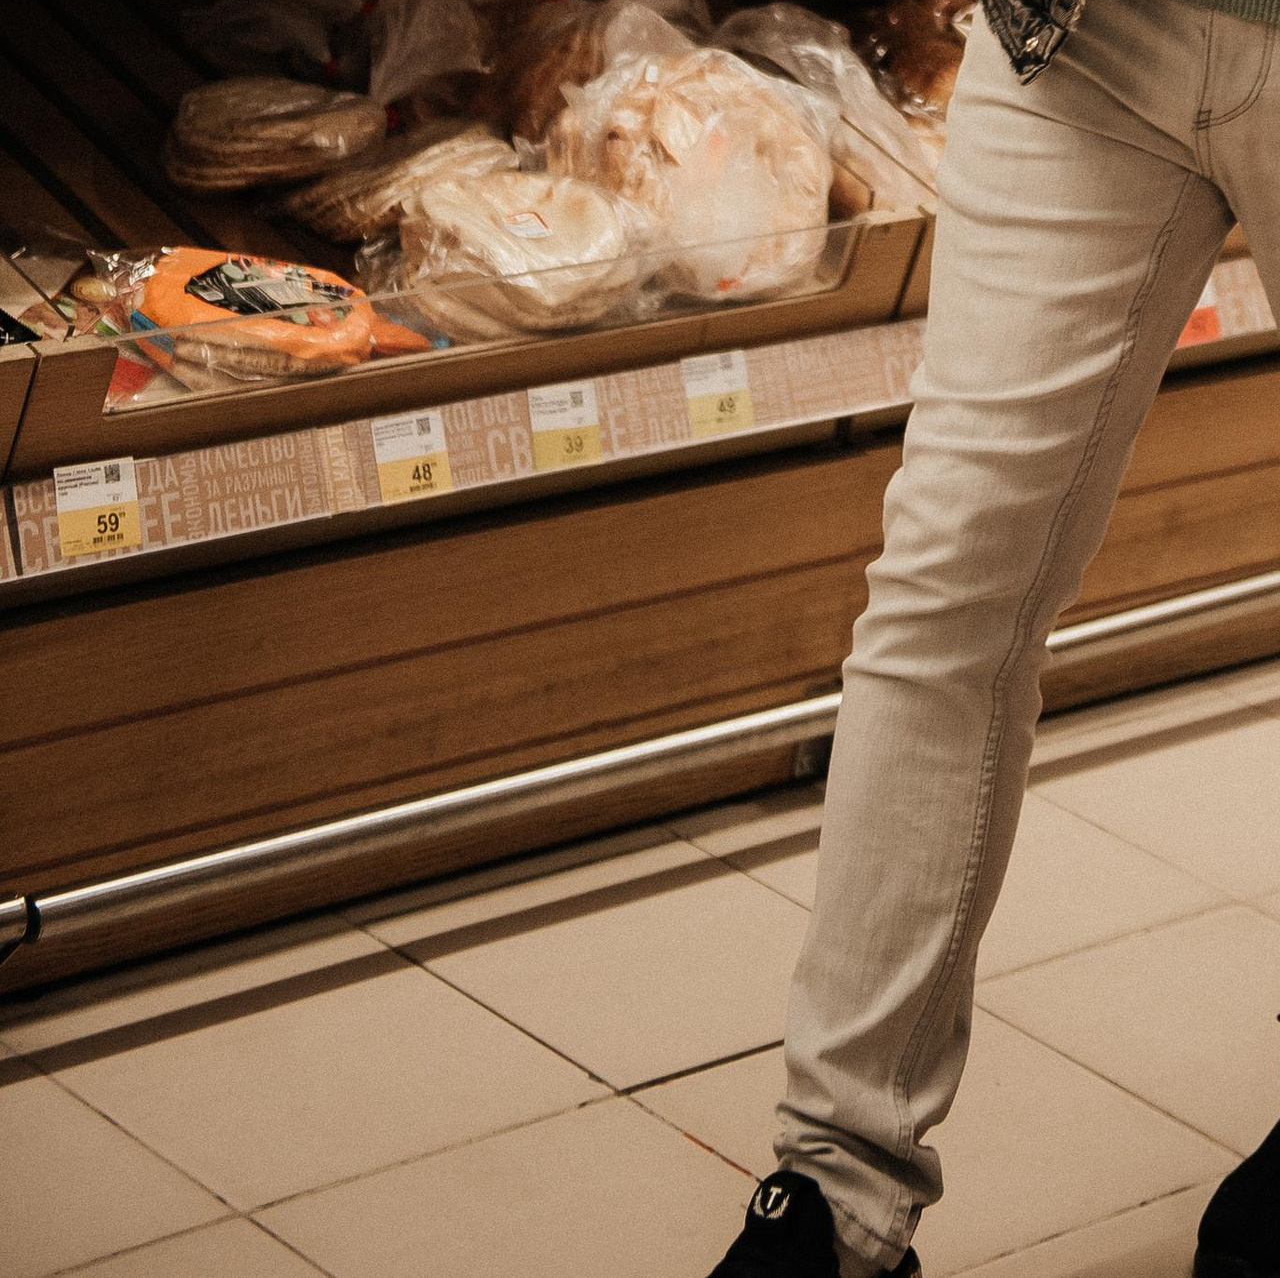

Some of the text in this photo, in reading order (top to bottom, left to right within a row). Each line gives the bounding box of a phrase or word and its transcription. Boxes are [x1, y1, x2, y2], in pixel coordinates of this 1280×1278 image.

[205, 464, 298, 499] ЗА РАЗУМНЫЕ
[412, 463, 433, 483] 48
[208, 485, 303, 536] ДЕНЬГИ
[97, 513, 120, 534] 59
[767, 1186, 782, 1209] T
